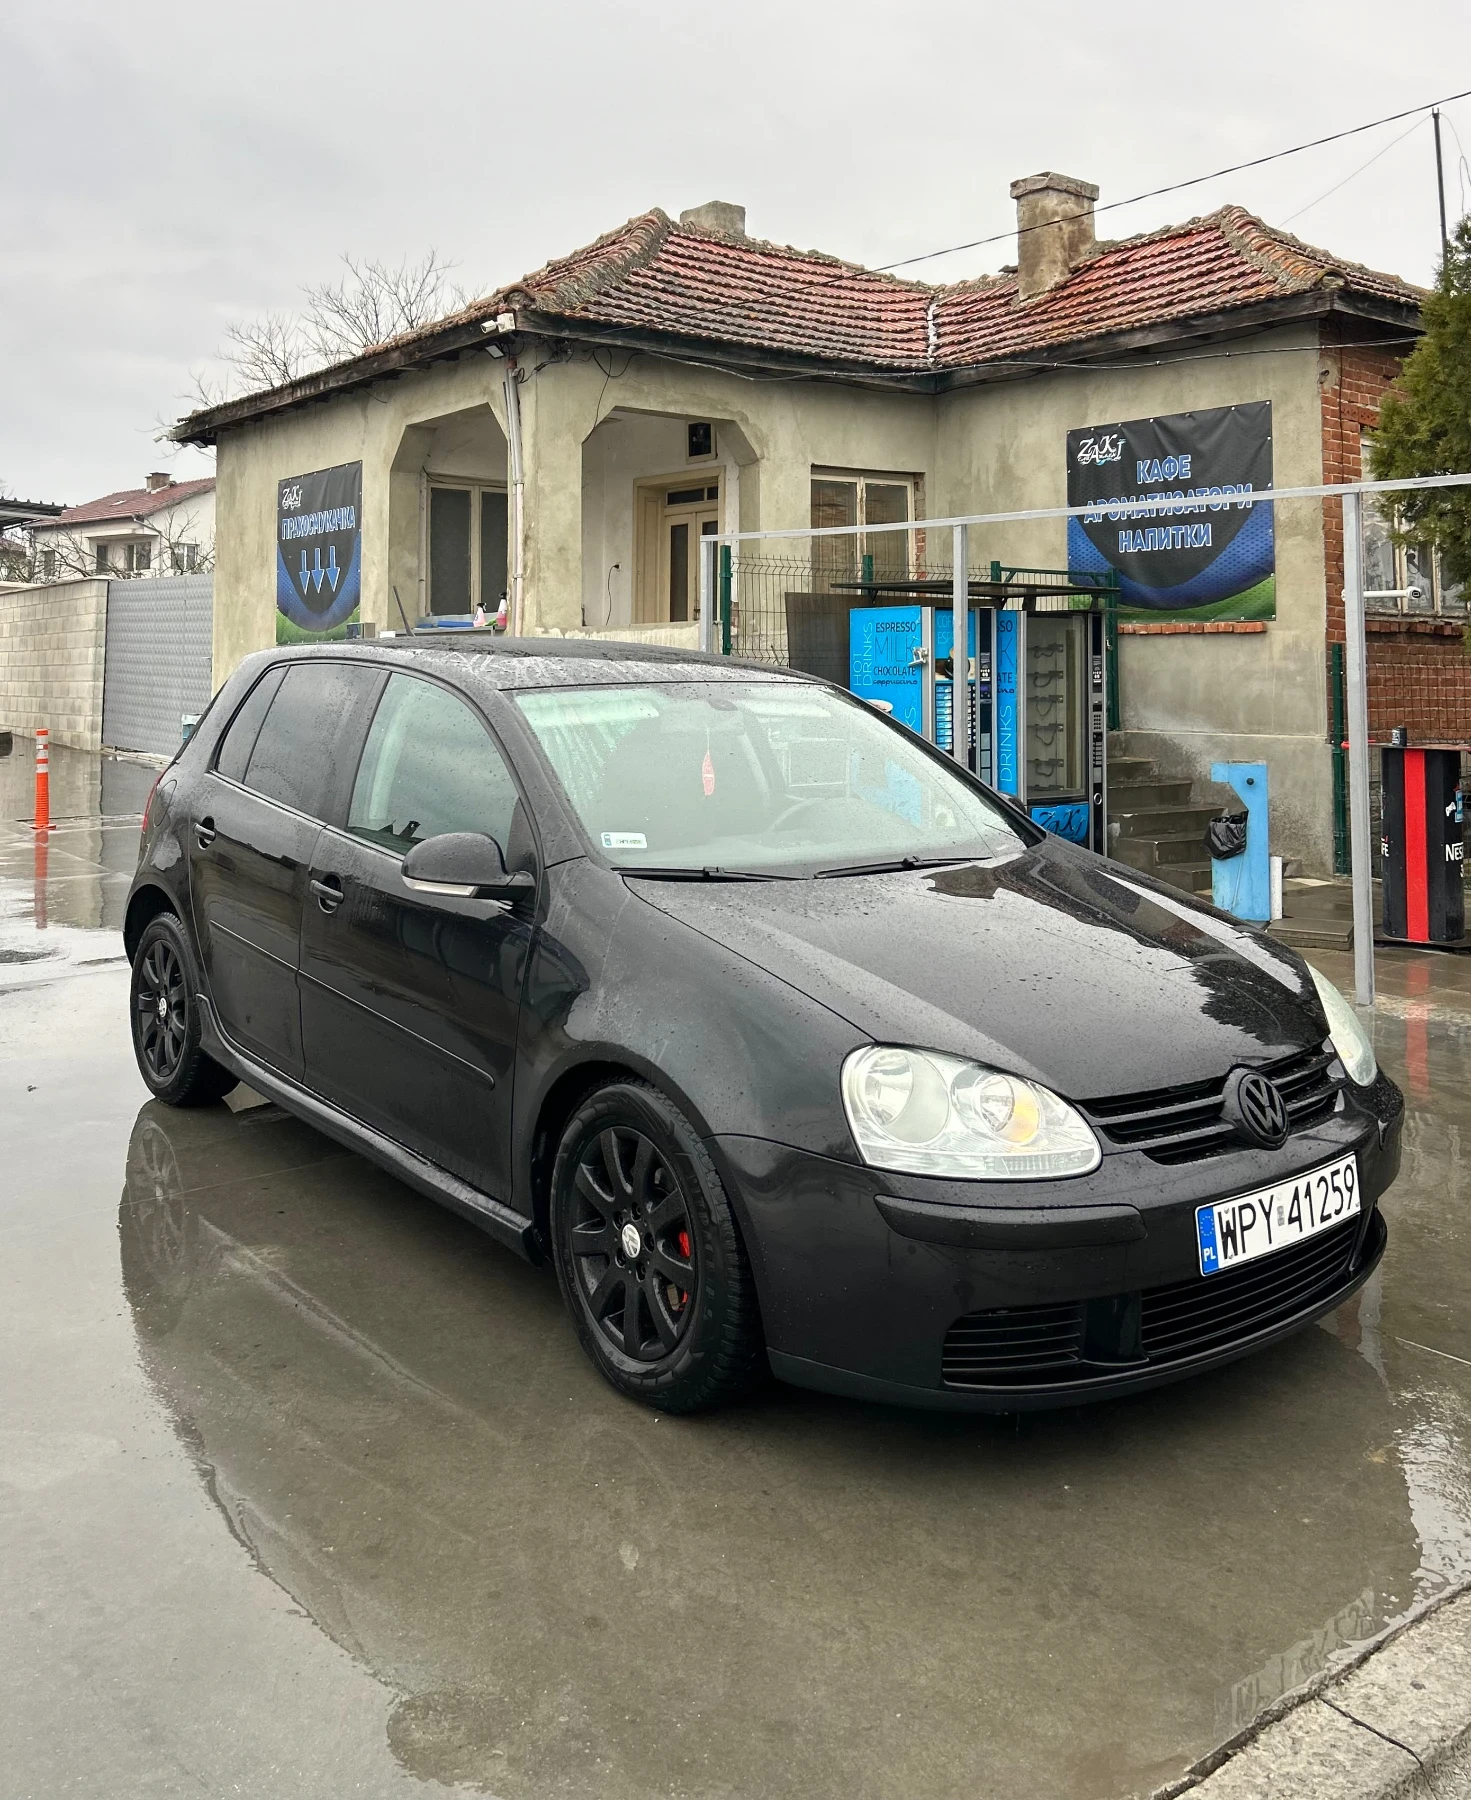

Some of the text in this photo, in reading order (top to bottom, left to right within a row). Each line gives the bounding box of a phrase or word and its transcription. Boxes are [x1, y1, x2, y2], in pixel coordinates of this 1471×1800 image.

[1137, 454, 1192, 484] КАФЕ
[1084, 483, 1252, 523] АРОМАТИЗАТОРИ
[282, 505, 355, 540] ПРАХОСМУКАЧКА
[1119, 523, 1212, 553] НАПИТКИ
[875, 622, 917, 633] ESPRESSO
[863, 622, 873, 686] DRINKS
[874, 635, 914, 662] MILK
[853, 650, 863, 686] HOT
[873, 665, 917, 676] CHOCOLATE
[873, 676, 918, 687] cappuccino
[1000, 705, 1013, 782] DRINKS
[1217, 1163, 1356, 1260] WPY 41259
[1203, 1247, 1216, 1262] PL
